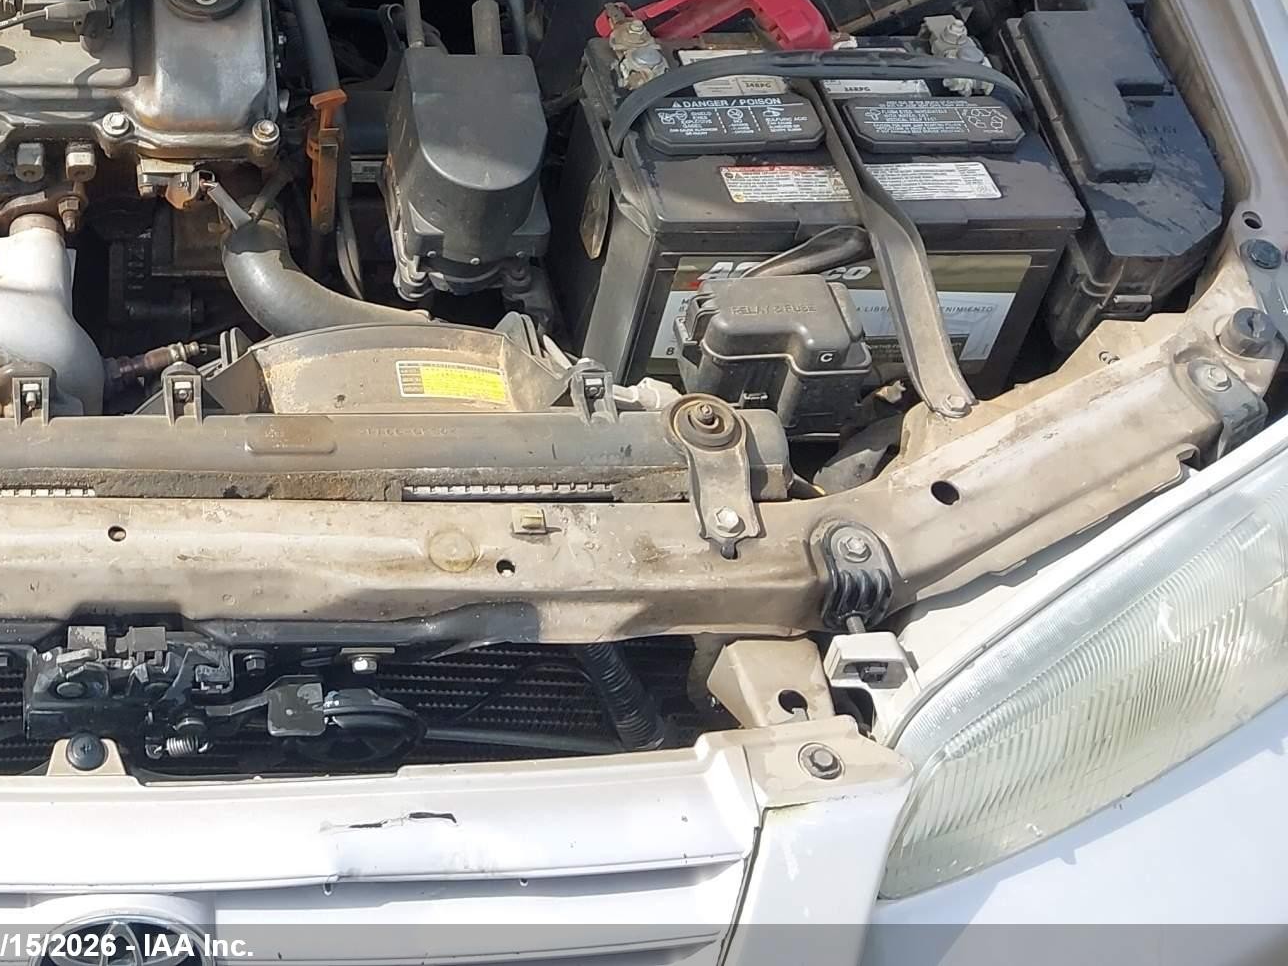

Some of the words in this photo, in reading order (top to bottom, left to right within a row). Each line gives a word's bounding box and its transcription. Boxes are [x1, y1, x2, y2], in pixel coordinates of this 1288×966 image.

[683, 99, 728, 108] DANGER
[739, 98, 782, 106] POISON
[730, 305, 770, 315] RELAY
[783, 304, 817, 313] FUSE
[820, 352, 834, 363] C
